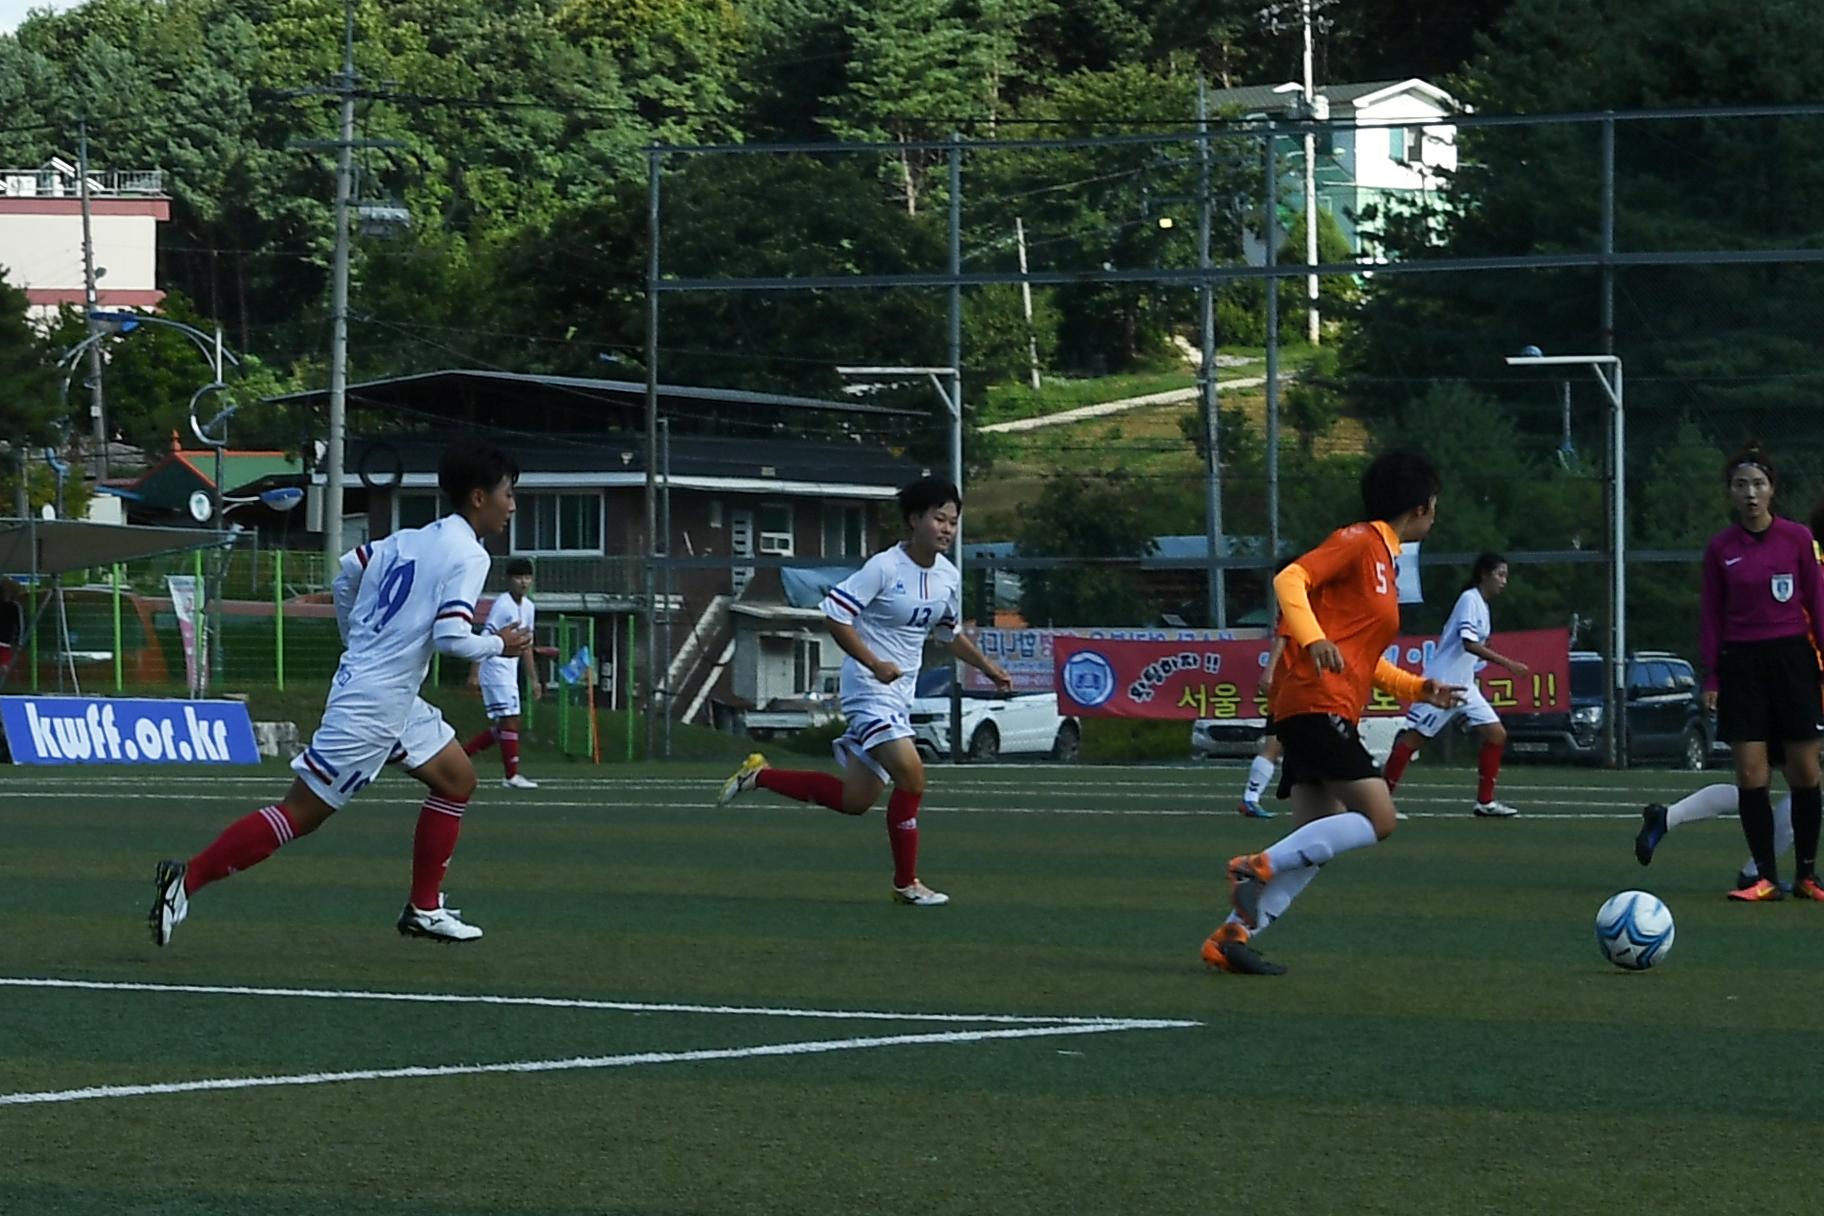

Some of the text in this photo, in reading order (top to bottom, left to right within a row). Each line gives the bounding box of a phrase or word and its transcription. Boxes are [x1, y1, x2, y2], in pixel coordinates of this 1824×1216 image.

[1376, 562, 1387, 595] 5
[906, 607, 932, 628] 13
[1177, 683, 1241, 718] 서울
[23, 702, 231, 762] kwff.or.kr
